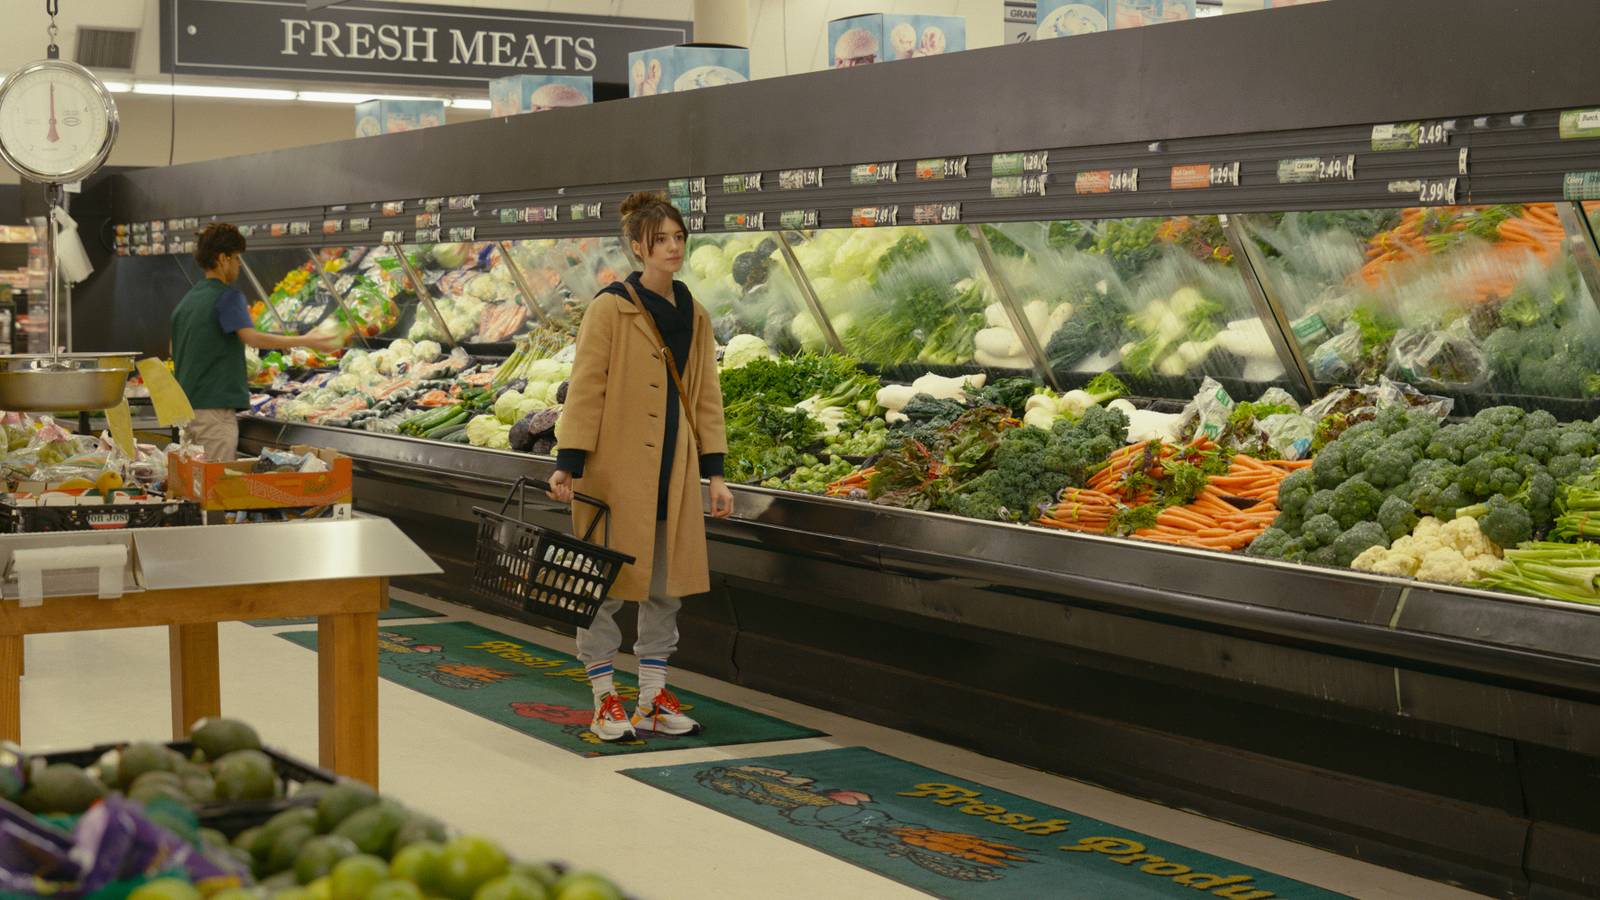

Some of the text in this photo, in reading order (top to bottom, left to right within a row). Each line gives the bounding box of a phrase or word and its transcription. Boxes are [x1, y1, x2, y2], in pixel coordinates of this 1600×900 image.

[280, 18, 598, 72] FRESH MEATS
[1418, 125, 1441, 144] 2.49
[1209, 167, 1228, 184] 1.29
[1320, 160, 1342, 179] 2.49
[1109, 173, 1128, 190] 2.49
[1419, 183, 1443, 202] 2.99
[337, 507, 344, 516] 4
[464, 641, 568, 669] Fresh
[895, 781, 1072, 836] Fresh
